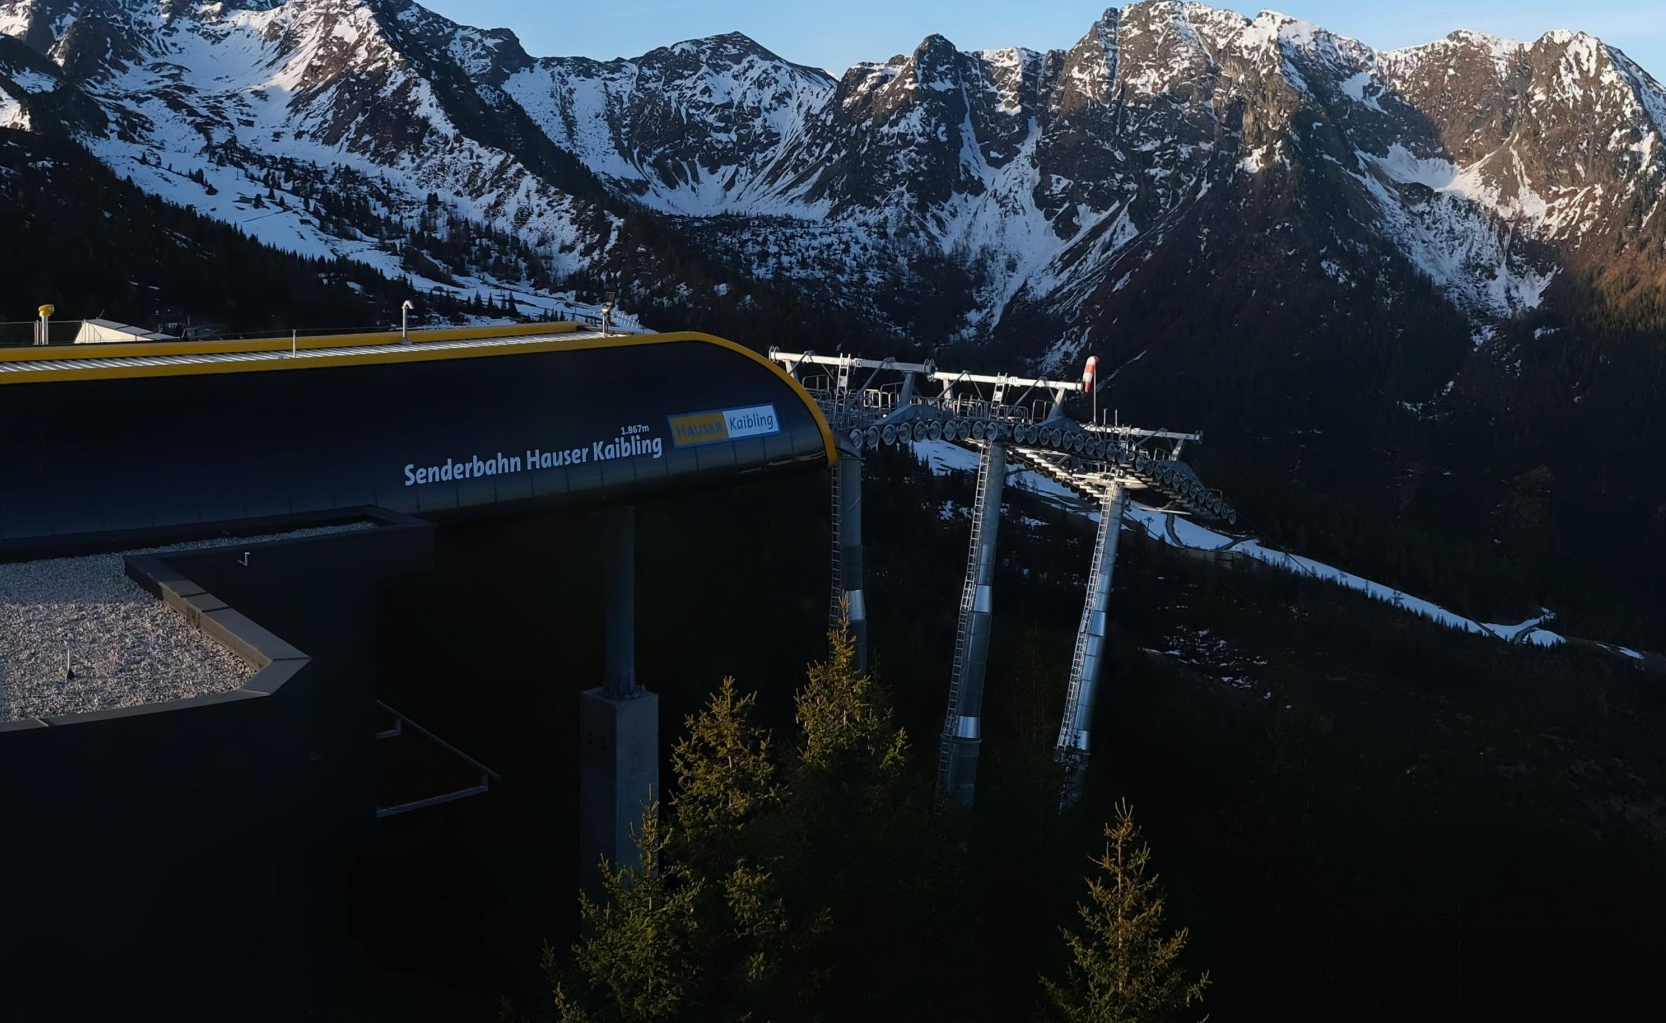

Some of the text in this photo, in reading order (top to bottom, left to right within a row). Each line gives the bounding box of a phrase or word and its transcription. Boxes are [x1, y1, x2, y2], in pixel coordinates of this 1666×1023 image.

[620, 424, 650, 435] 1.867m
[729, 413, 774, 431] Kaibling
[404, 435, 662, 487] Senderbahn Hauser Kaibling
